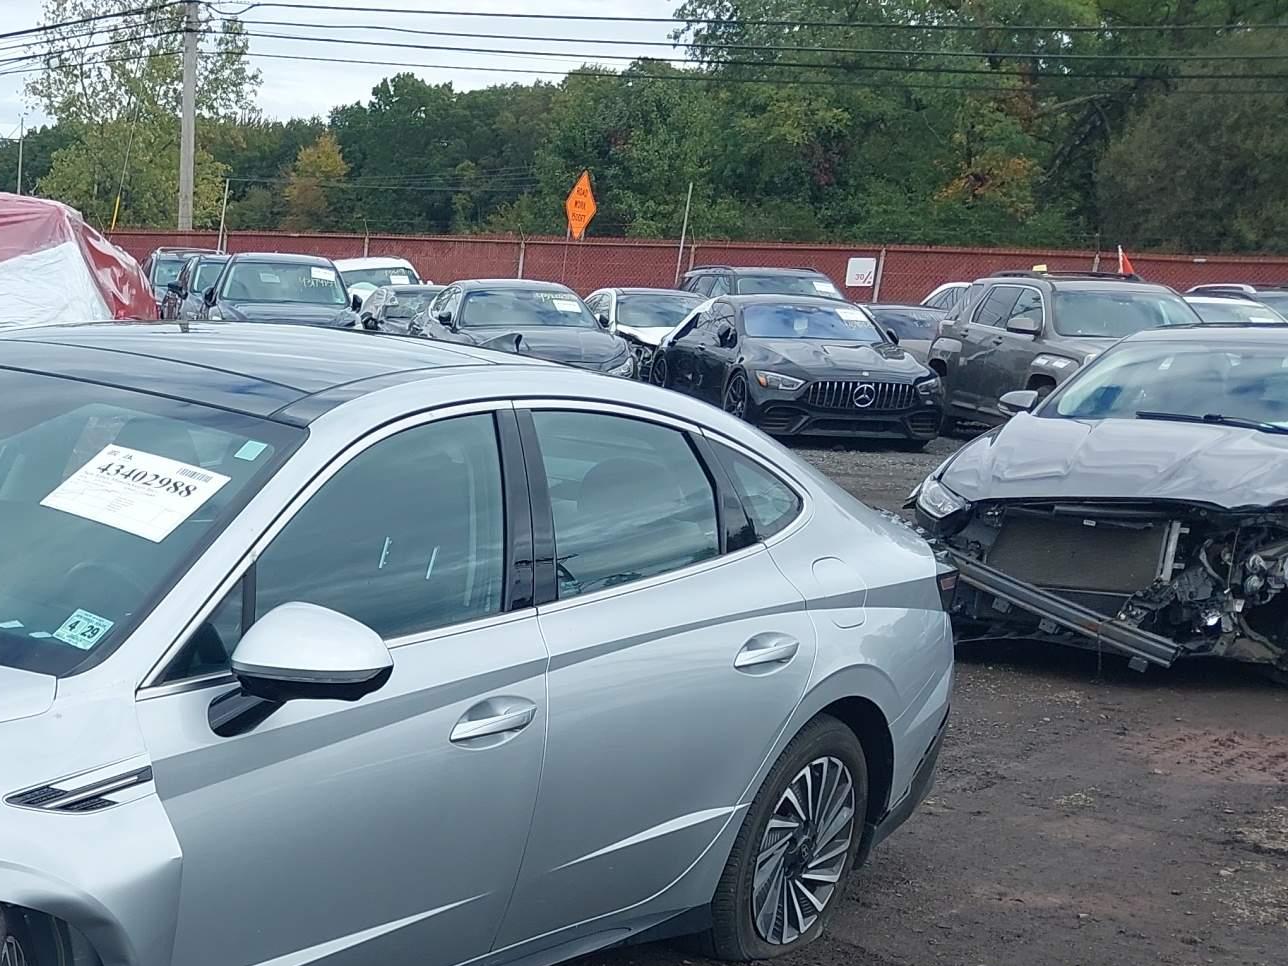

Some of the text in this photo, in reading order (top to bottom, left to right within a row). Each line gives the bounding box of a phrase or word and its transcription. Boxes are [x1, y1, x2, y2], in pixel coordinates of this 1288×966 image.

[96, 461, 198, 498] 43402988
[68, 620, 81, 632] 4
[80, 624, 100, 639] 29
